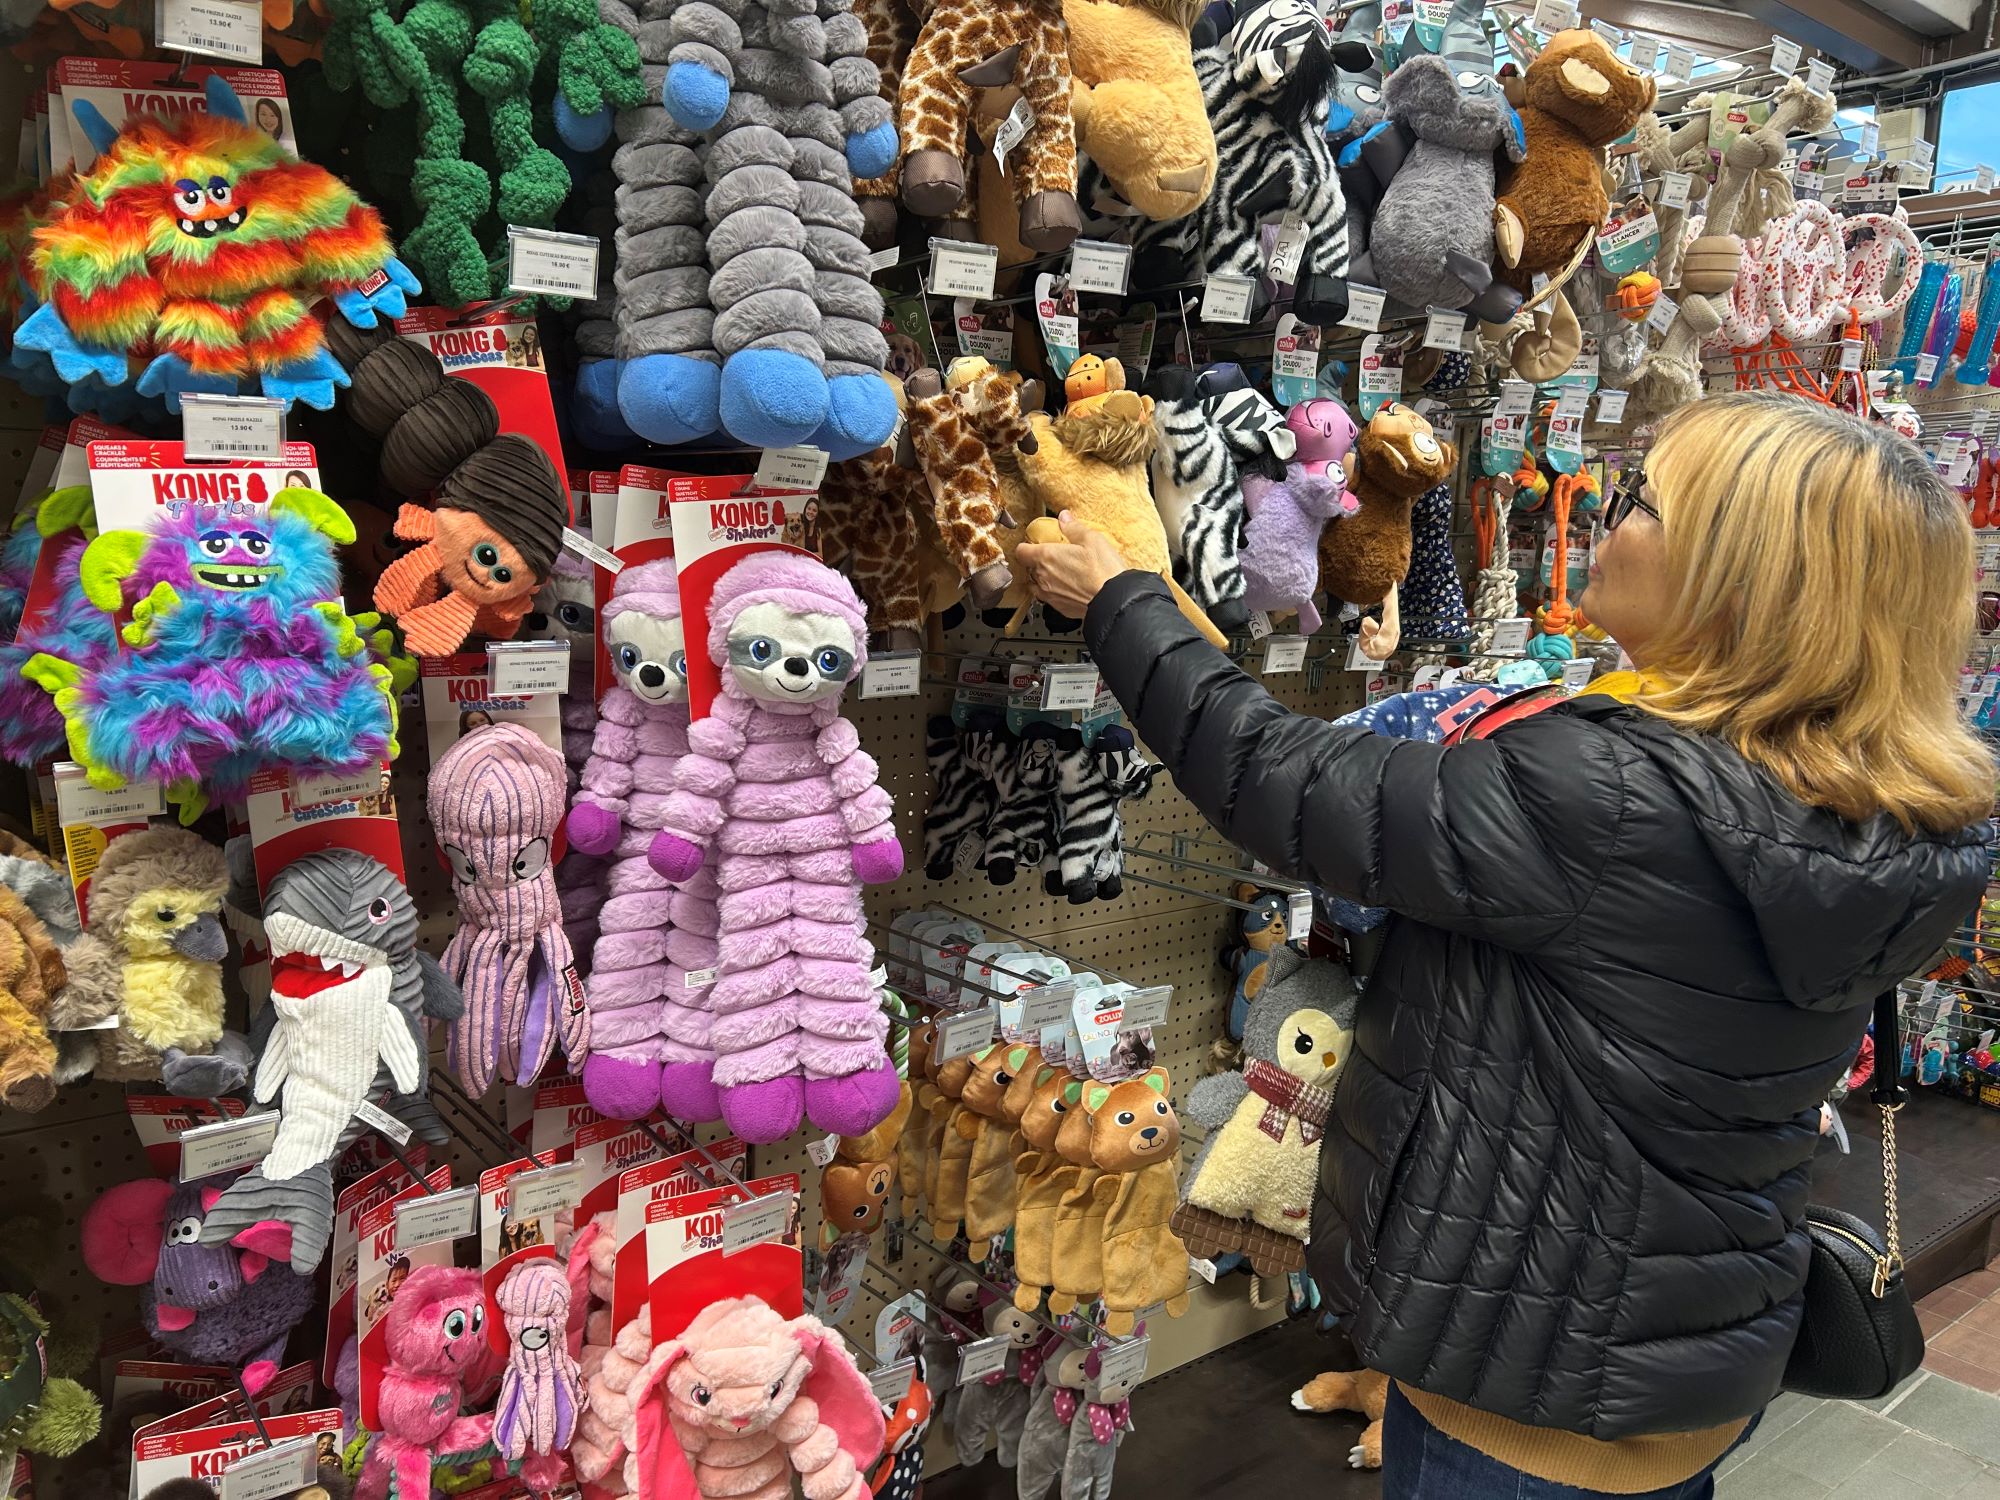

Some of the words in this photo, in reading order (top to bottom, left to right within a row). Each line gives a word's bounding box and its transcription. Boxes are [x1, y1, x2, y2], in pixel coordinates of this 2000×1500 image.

[1425, 30, 1432, 42] L
[1617, 228, 1640, 241] LANCER
[429, 330, 491, 357] KONG
[969, 341, 991, 350] DOUDOU
[443, 351, 503, 367] CuteSeas
[1282, 360, 1302, 368] DOUDOU
[1368, 377, 1387, 385] DOUDOU
[1277, 383, 1285, 395] M
[1363, 400, 1371, 411] M
[152, 473, 242, 504] KONG
[710, 502, 769, 532] KONG
[726, 524, 776, 542] Shakers
[968, 690, 993, 699] DOUDOU
[459, 700, 526, 711] CuteSeas
[959, 710, 966, 720] S
[1016, 716, 1023, 726] S
[1087, 729, 1093, 740] S
[293, 802, 356, 822] CuteSeas
[1098, 1011, 1124, 1023] ZOLUX
[616, 1145, 658, 1168] Shakers
[889, 1317, 912, 1335] ZOLUX
